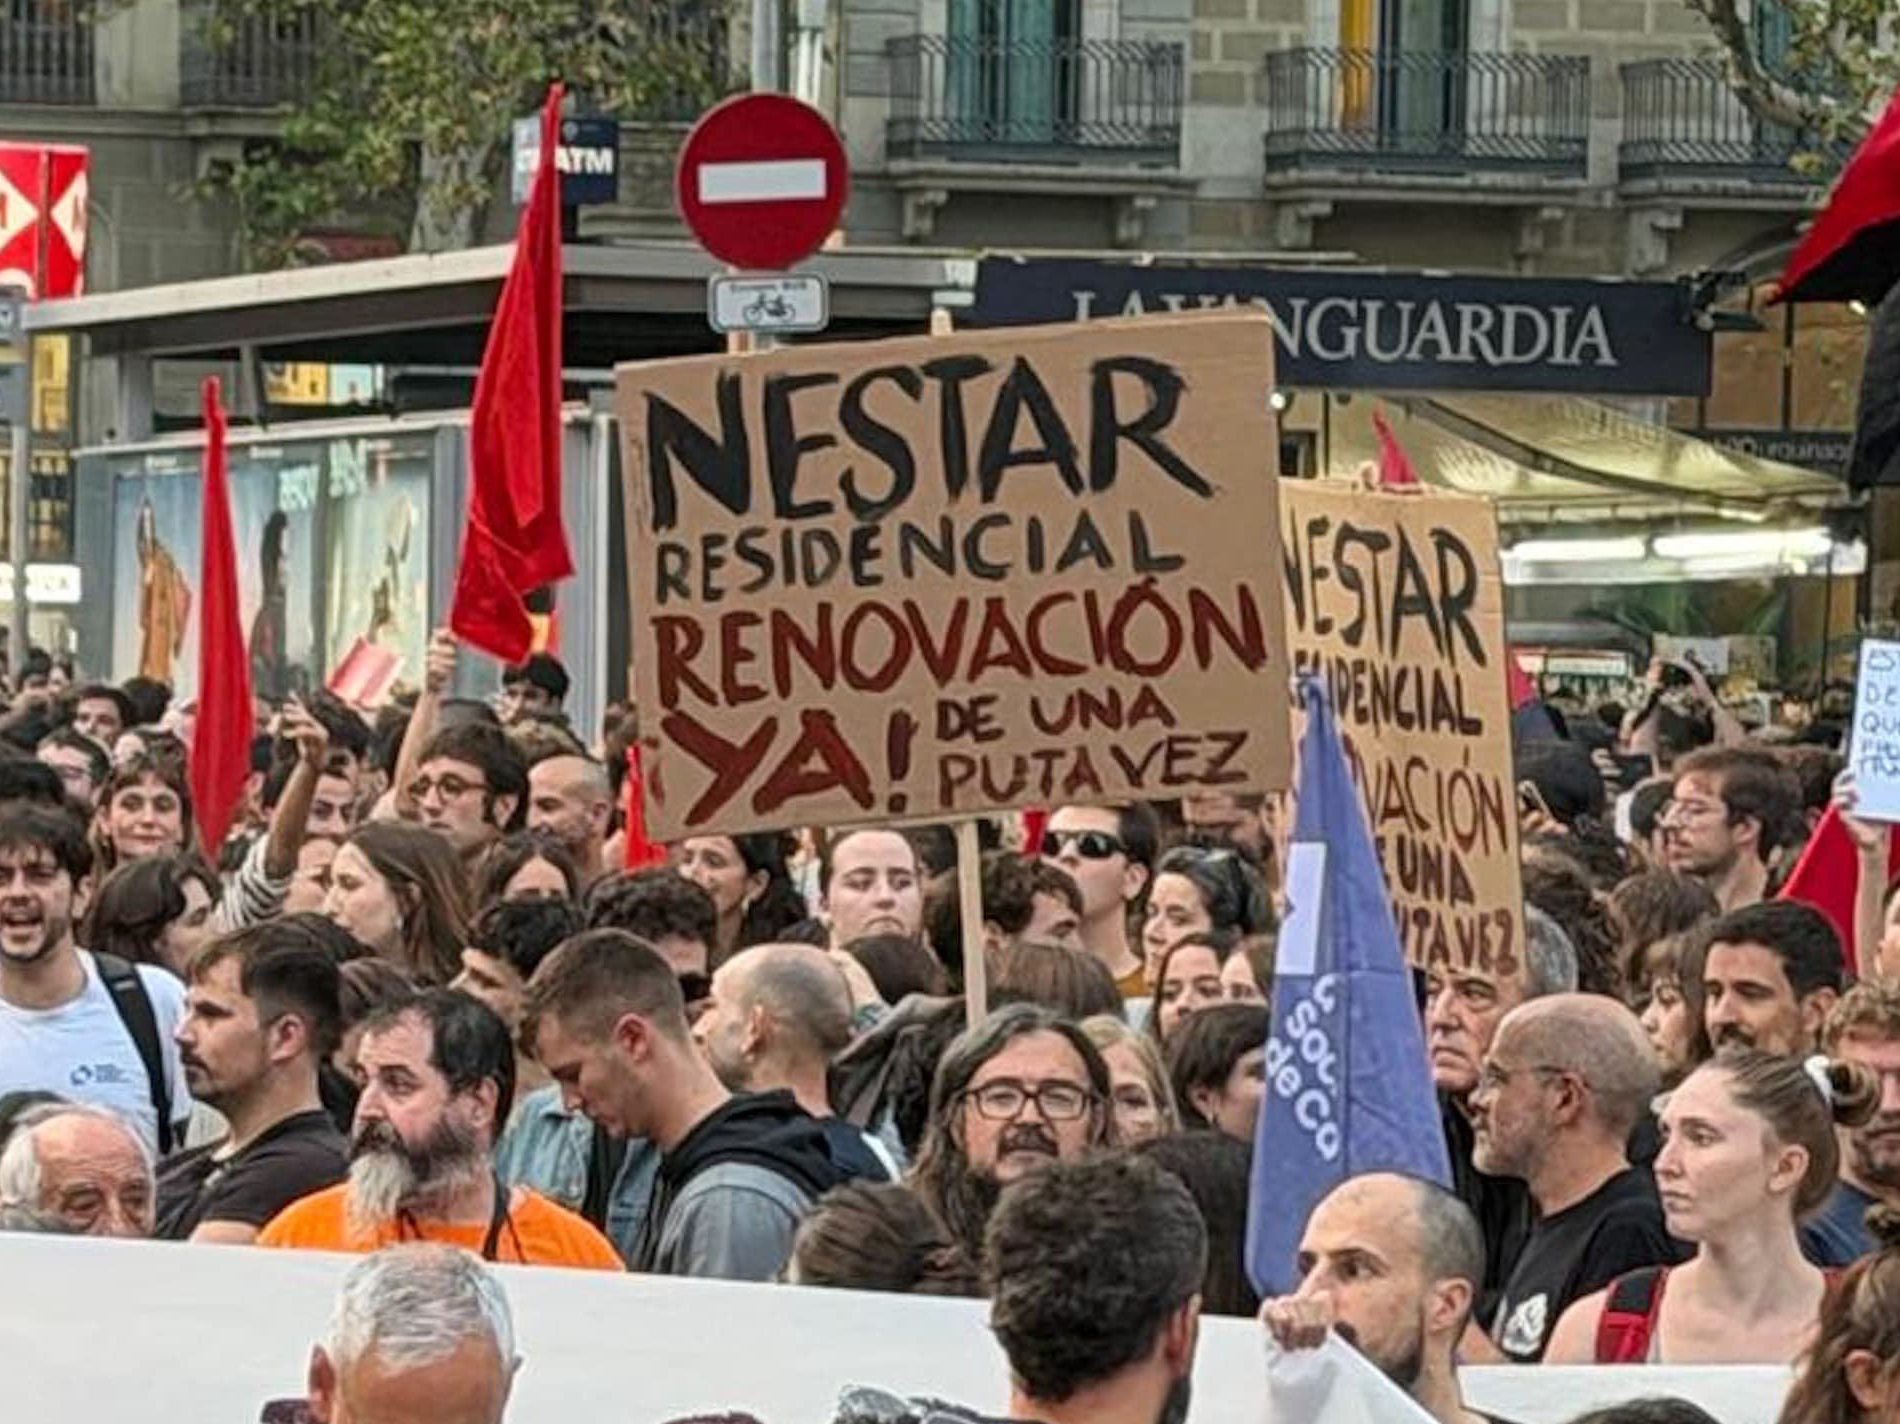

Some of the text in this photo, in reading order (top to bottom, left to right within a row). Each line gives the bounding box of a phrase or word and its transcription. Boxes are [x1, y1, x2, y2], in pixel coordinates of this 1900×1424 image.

[555, 147, 614, 174] ATM
[1158, 292, 1618, 367] NGUARDIA
[643, 355, 1218, 532] NESTAR
[656, 509, 1186, 605] RESIDENCIAL
[1282, 508, 1488, 671] NESTAR
[650, 577, 1269, 712] RENOVACIÓN
[935, 685, 1178, 742] DE UNA
[938, 730, 1250, 809] PUTA VEZ
[1343, 734, 1508, 857] VACIÓN
[1396, 834, 1476, 908] UNA
